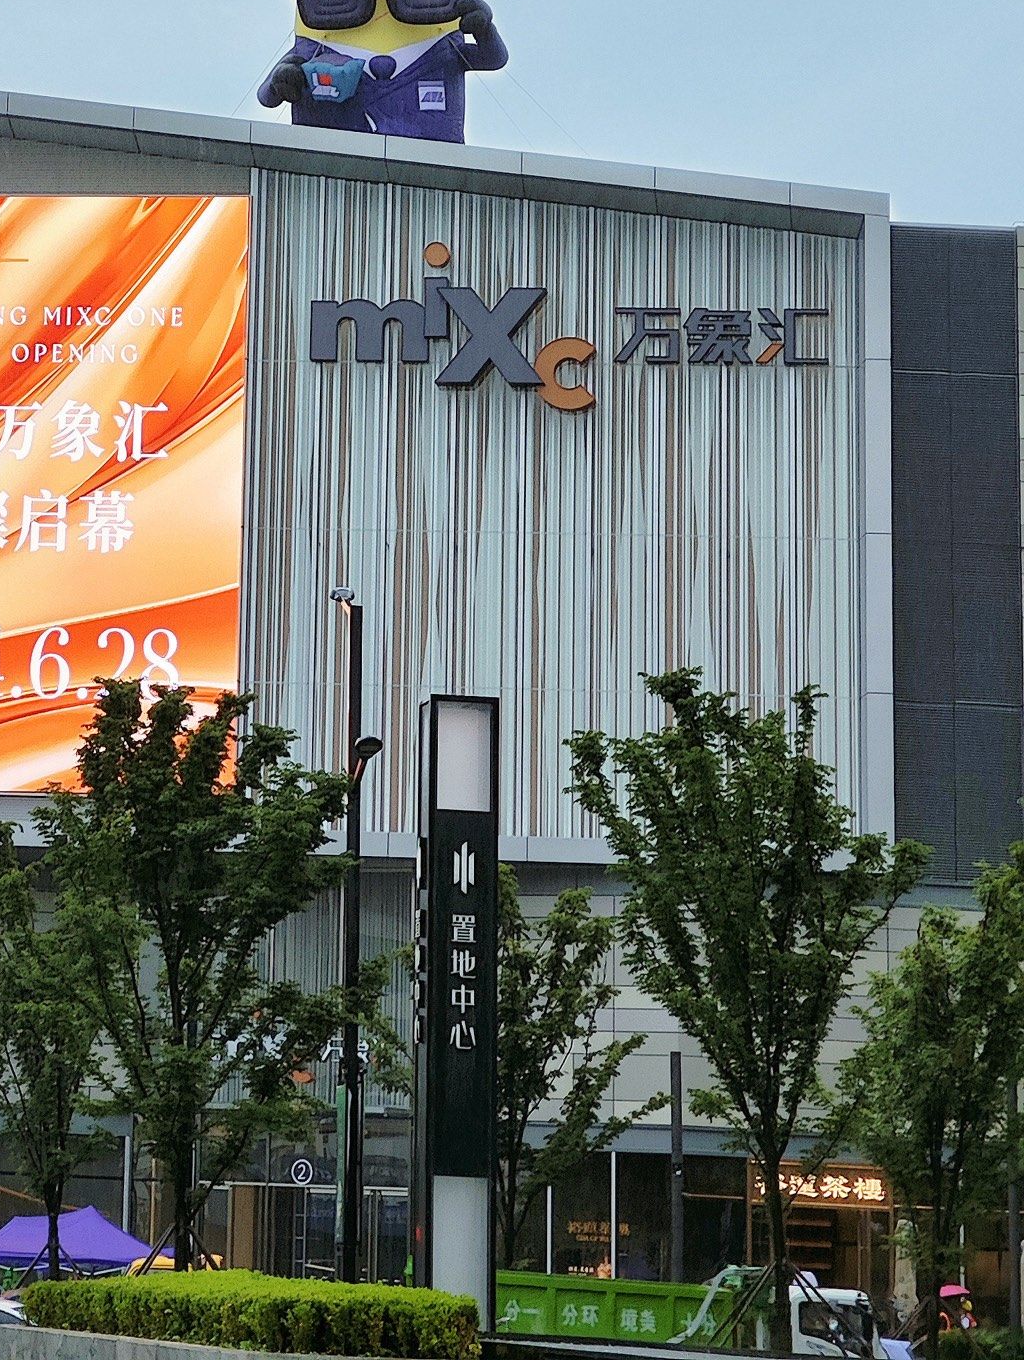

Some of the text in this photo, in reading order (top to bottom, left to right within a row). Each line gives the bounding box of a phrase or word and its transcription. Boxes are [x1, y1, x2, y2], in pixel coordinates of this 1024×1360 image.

[43, 306, 112, 327] MIXC
[127, 307, 185, 327] ONE
[613, 306, 830, 366] 万象汇
[11, 343, 140, 365] OPENING
[450, 913, 477, 1051] 置地中心
